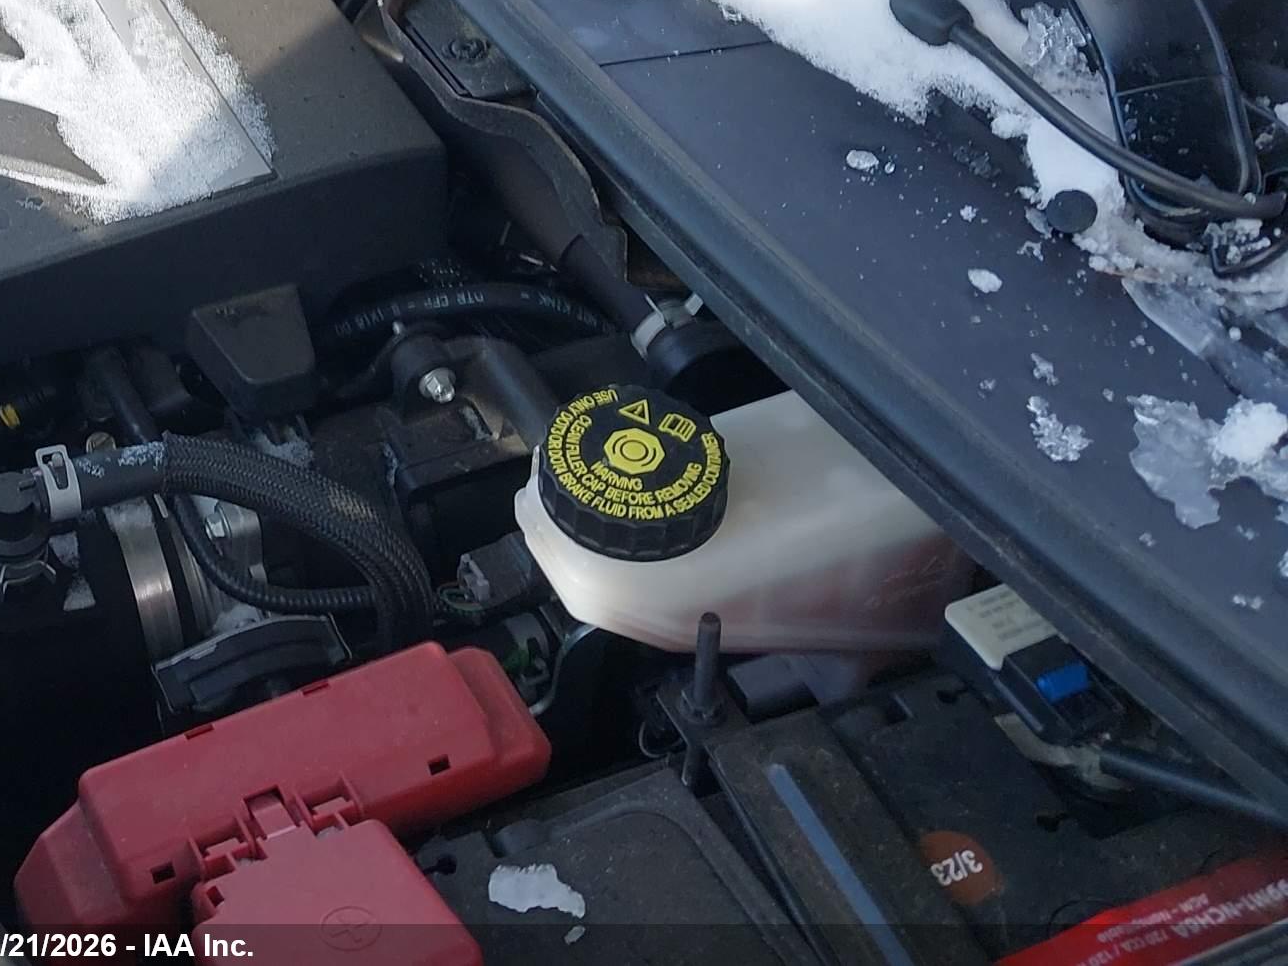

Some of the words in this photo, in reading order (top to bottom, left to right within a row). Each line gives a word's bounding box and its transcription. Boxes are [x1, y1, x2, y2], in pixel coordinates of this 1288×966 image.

[568, 395, 596, 418] ONLY
[592, 389, 618, 406] USE
[566, 414, 592, 444] CLEAN
[548, 435, 563, 450] OR
[565, 443, 588, 478] FILLER
[700, 432, 722, 486] CONTAINER
[558, 472, 595, 504] BRAKE
[581, 473, 606, 492] CAP
[590, 460, 644, 492] WARNING
[654, 462, 703, 503] REMOVING
[591, 495, 627, 518] FLUID
[604, 486, 656, 506] BEFORE
[672, 481, 712, 513] SEALED
[628, 504, 665, 520] FROM
[665, 502, 677, 517] A
[930, 849, 984, 887] 3/23
